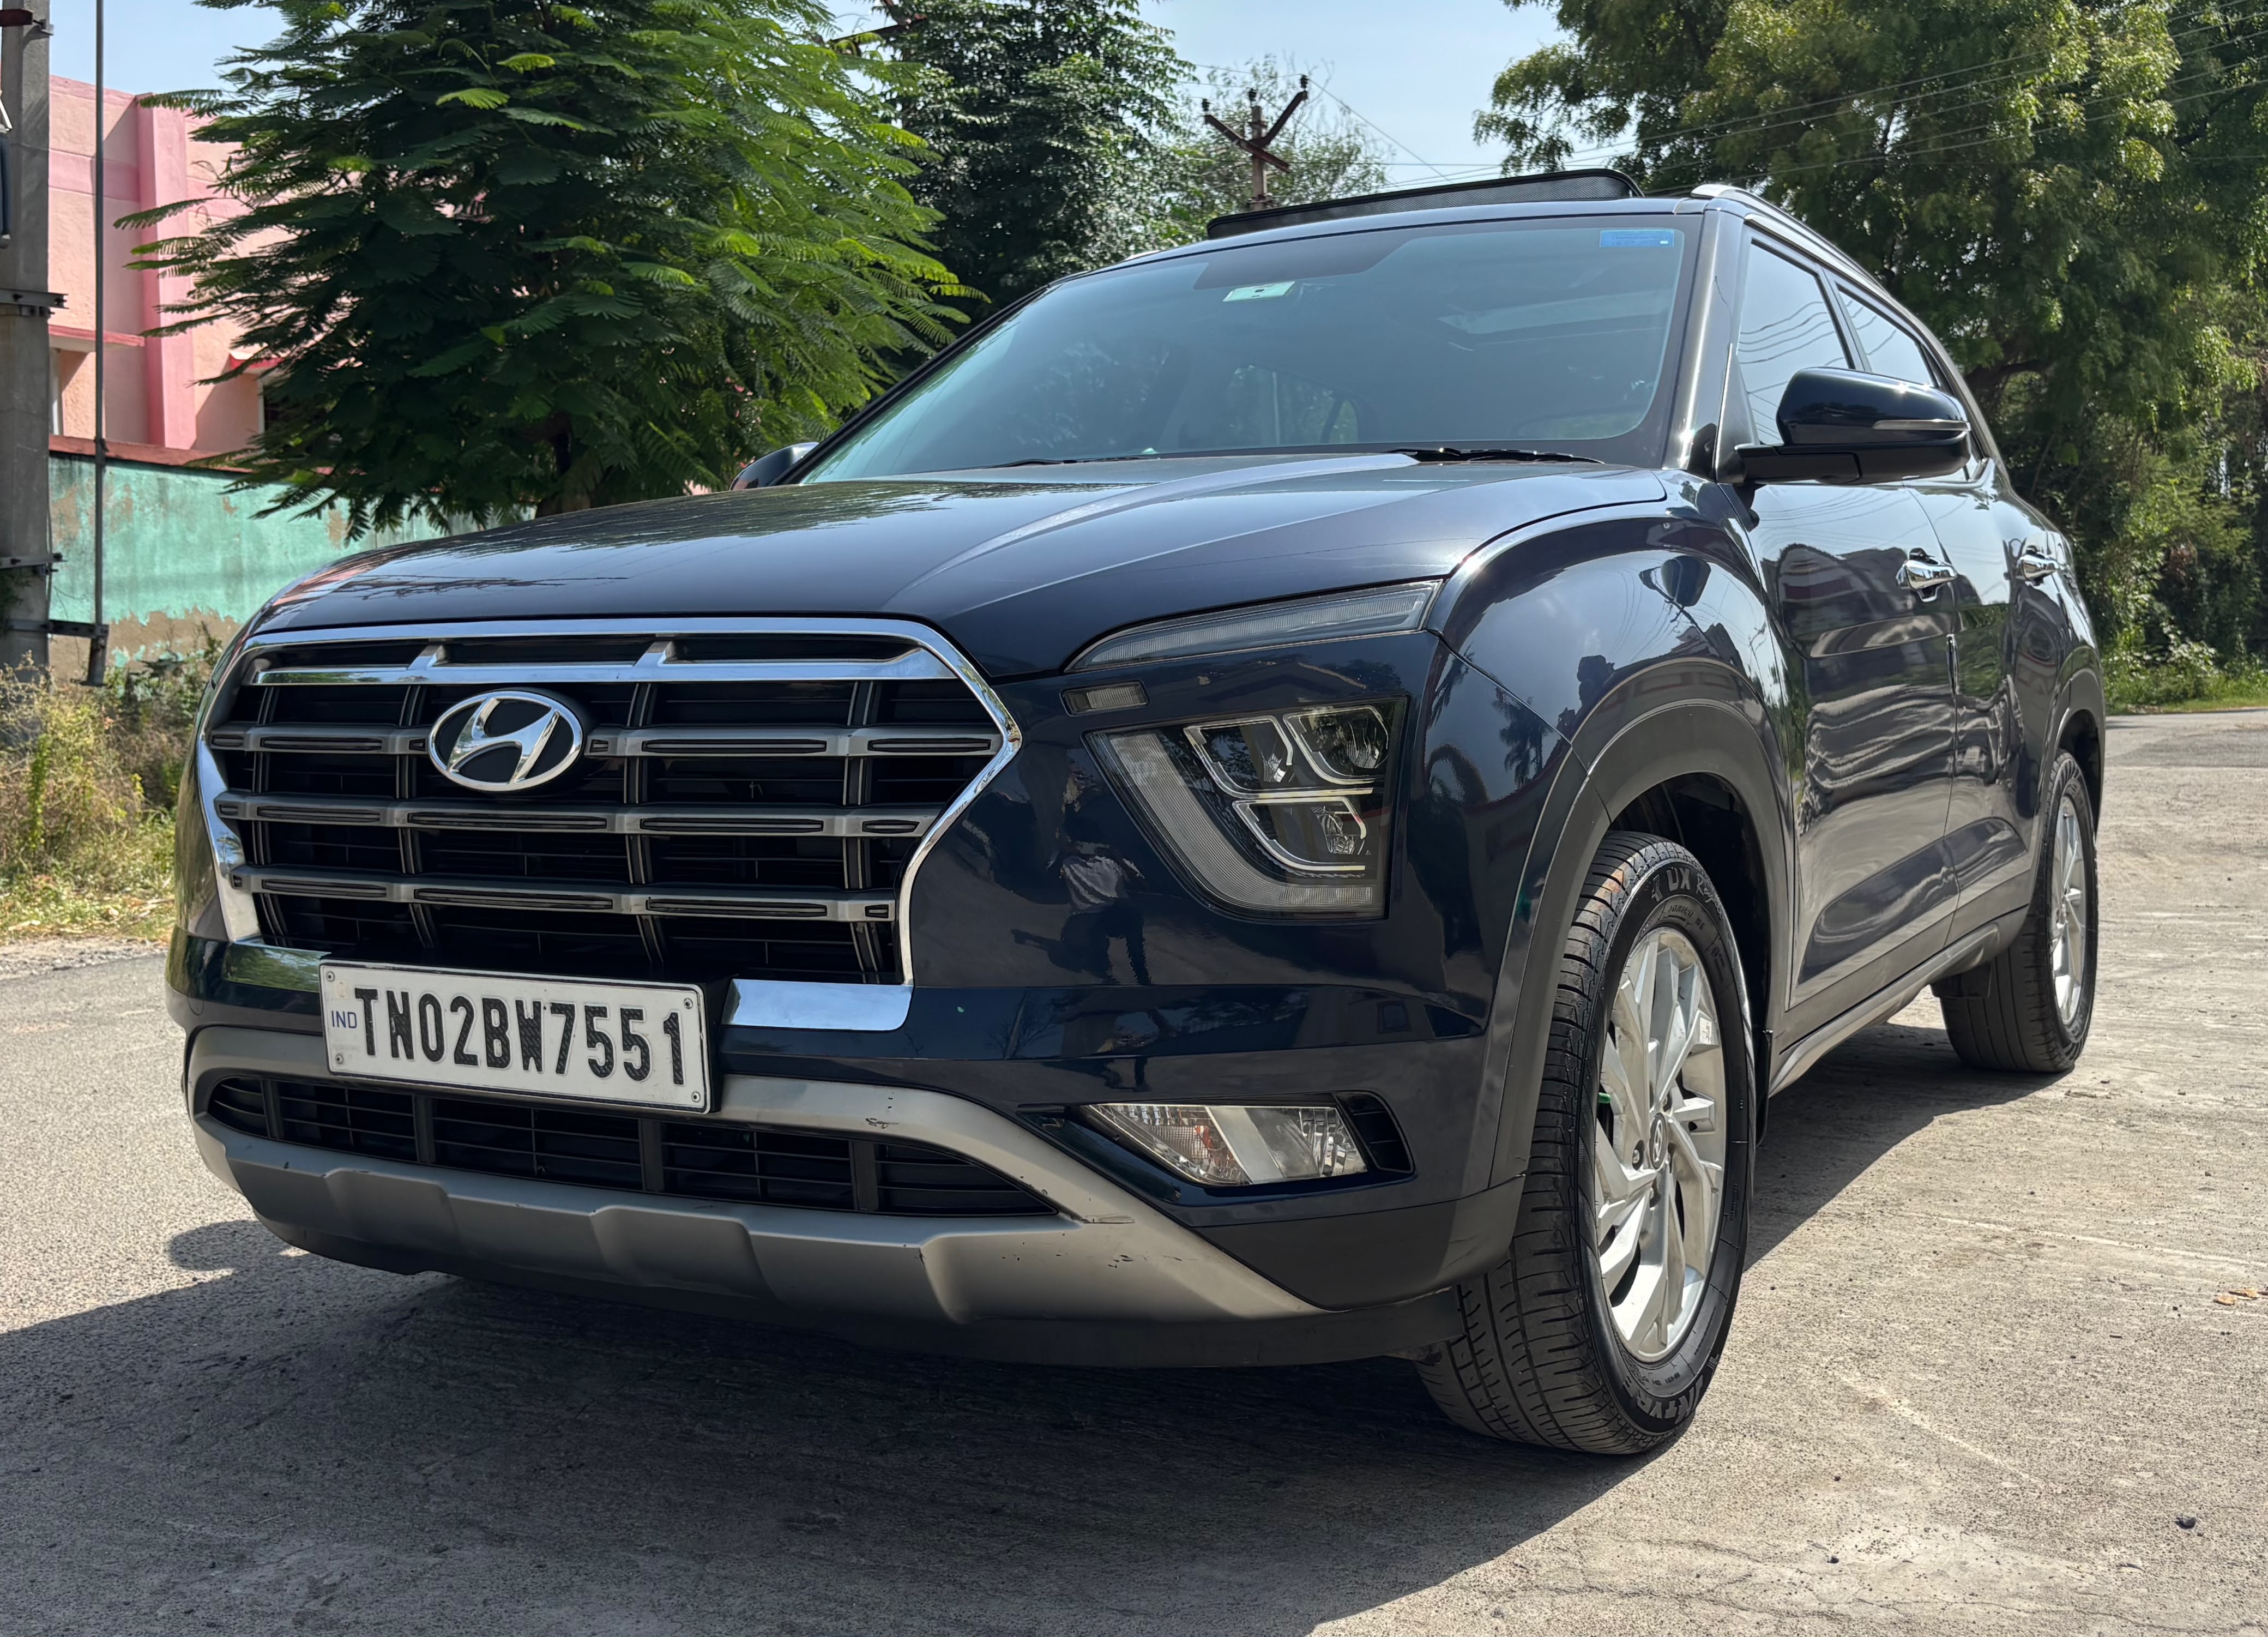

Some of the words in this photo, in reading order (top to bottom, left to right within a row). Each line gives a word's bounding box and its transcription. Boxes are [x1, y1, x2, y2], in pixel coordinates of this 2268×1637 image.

[1666, 868, 1690, 892] UX
[331, 1010, 357, 1028] IND
[355, 988, 685, 1085] TN02BW7551
